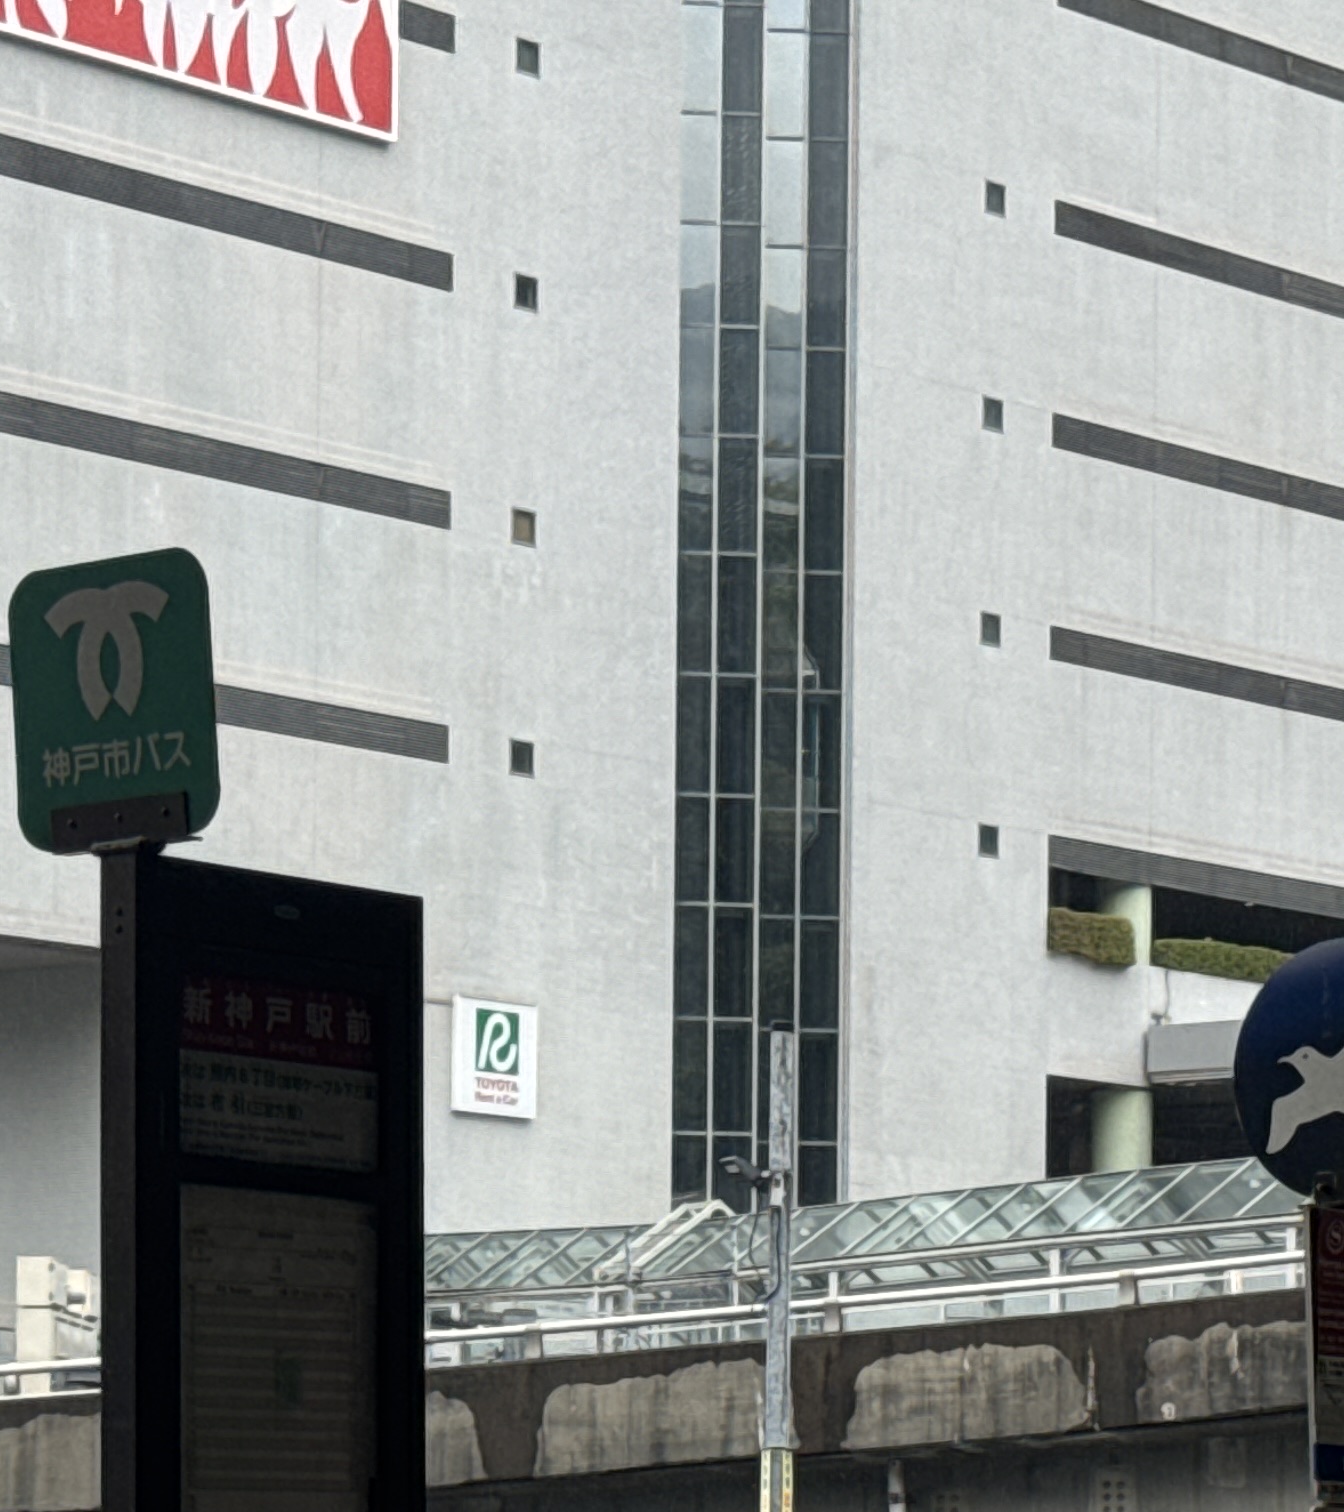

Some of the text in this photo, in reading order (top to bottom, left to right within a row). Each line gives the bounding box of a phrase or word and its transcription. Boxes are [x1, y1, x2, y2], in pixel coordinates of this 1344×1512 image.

[42, 731, 191, 788] 神戸市バス
[183, 985, 372, 1046] 新神戸駅前
[474, 1076, 520, 1093] TOYOTA
